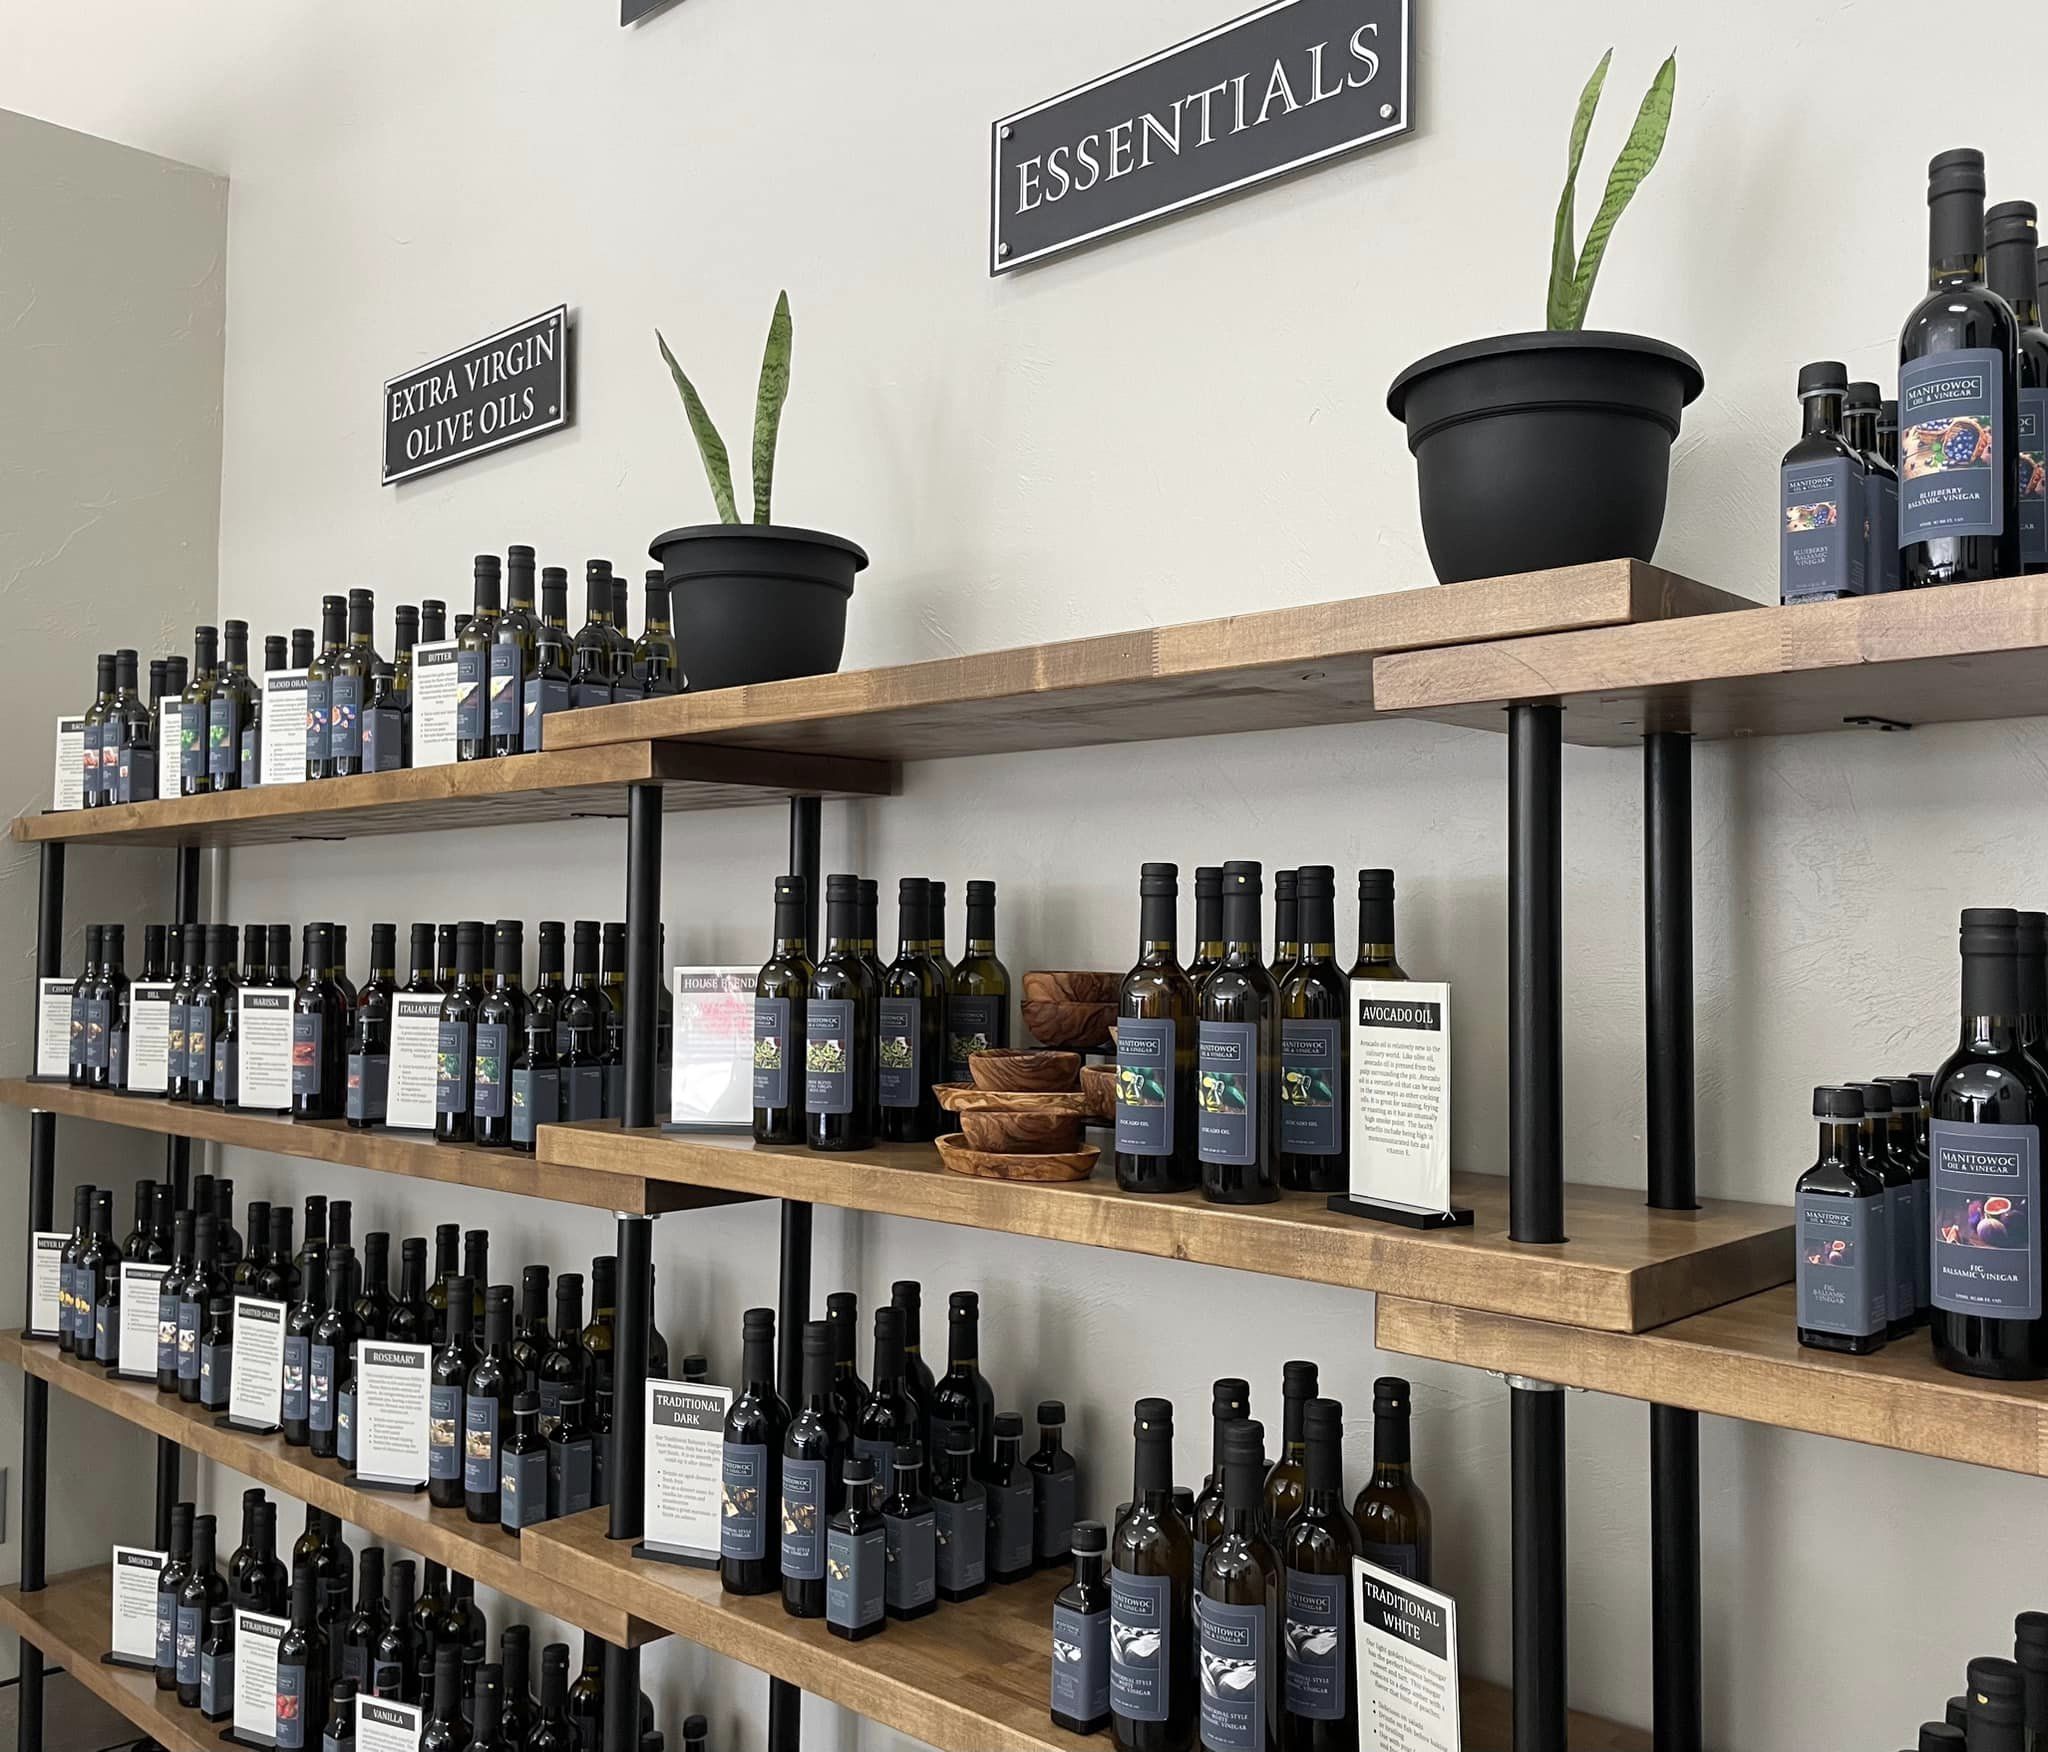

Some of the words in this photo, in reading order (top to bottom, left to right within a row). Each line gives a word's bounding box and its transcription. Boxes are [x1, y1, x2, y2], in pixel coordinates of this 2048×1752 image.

[1015, 22, 1380, 216] ESSENTIALS
[391, 369, 458, 422] EXTRA
[464, 328, 556, 392] VIRGIN
[1908, 379, 1979, 399] MANITOWOC
[1912, 397, 1924, 406] OIL
[1934, 389, 1972, 400] VINEGAR
[406, 408, 474, 461] OLIVE
[479, 386, 535, 434] OILS
[1789, 476, 1833, 489] MANITOWOC
[1907, 496, 1941, 510] BALSAMIC
[1943, 492, 1981, 502] VINEGAR
[1920, 487, 1963, 499] BLUEBERRY
[1796, 557, 1826, 567] VINEGAR
[428, 652, 453, 664] BUTTER
[270, 680, 291, 689] BLOOD
[684, 977, 719, 990] HOUSE
[721, 977, 757, 990] BEND
[400, 1004, 428, 1015] ITALIAN
[1362, 1005, 1413, 1024] AVOCADO
[1414, 1009, 1434, 1024] OIL
[1942, 1151, 2016, 1167] MANITOWOC
[1947, 1162, 1959, 1170] OIL
[1969, 1164, 2009, 1174] VINEGAR
[1806, 1211, 1852, 1223] MANITOWOC
[1942, 1266, 1978, 1279] BALSAMIC
[1980, 1272, 2019, 1282] VINEGAR
[1970, 1264, 1984, 1272] FIG
[373, 1352, 416, 1365] ROSEMARY
[655, 1394, 721, 1413] TRADITIONAL
[673, 1411, 700, 1425] DARK
[1364, 1580, 1441, 1628] TRADITIONAL
[242, 1620, 282, 1637] STRAWBERRY
[1382, 1610, 1422, 1641] WHITE
[373, 1707, 404, 1725] VANILLA
